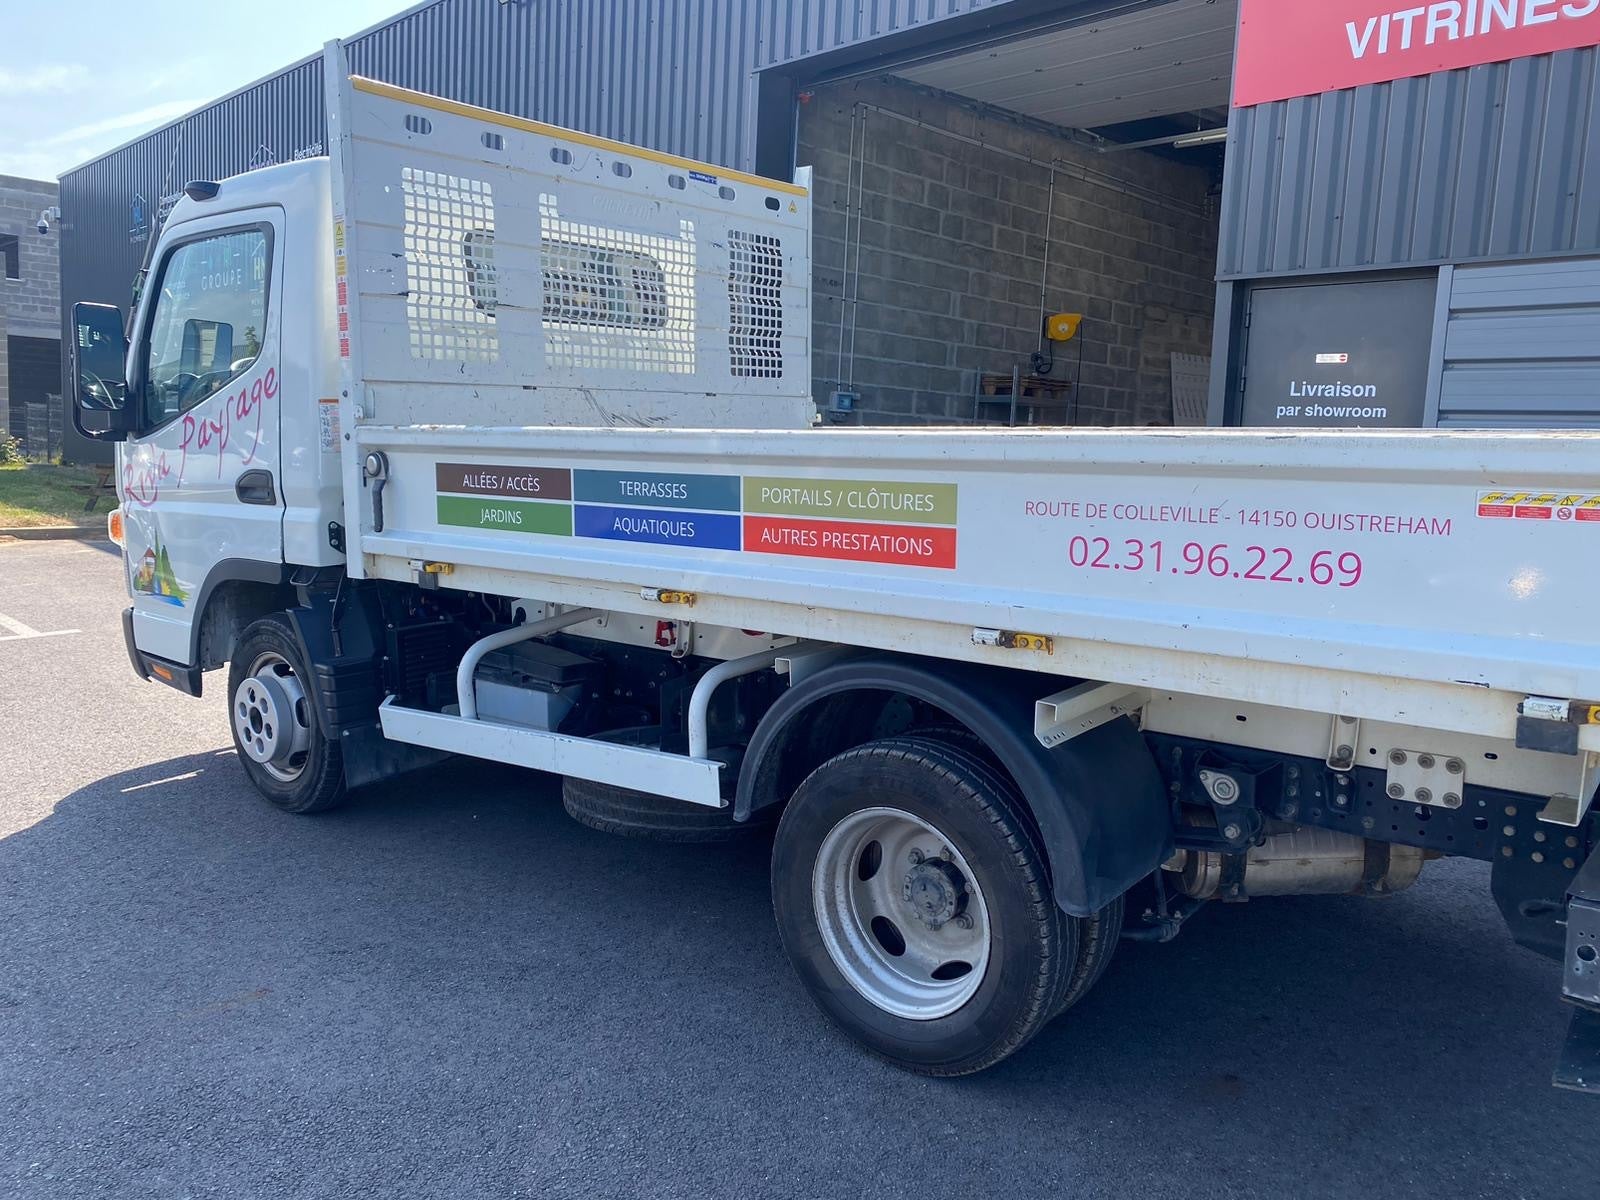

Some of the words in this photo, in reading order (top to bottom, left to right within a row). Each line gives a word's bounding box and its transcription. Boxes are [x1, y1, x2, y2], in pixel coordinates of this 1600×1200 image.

[201, 269, 242, 291] GROUPE
[1289, 381, 1377, 397] Livraison
[1276, 405, 1301, 419] par
[1304, 403, 1387, 418] showroom
[177, 367, 278, 489] Paysage
[462, 471, 498, 489] ALLÉES
[500, 476, 505, 489] /
[506, 473, 540, 492] ACCÈS
[619, 480, 688, 499] TERRASSES
[761, 487, 832, 507] PORTAILS
[836, 491, 843, 507] /
[847, 487, 935, 512] CLÔTURES
[480, 508, 522, 524] JARDINS
[1025, 501, 1080, 518] ROUTE
[1085, 503, 1108, 519] DE
[1113, 504, 1218, 524] COLLEVILLE
[1237, 509, 1297, 528] 14150
[1304, 512, 1451, 536] OUISTREHAM
[613, 517, 695, 538] AQUATIQUES
[761, 527, 818, 547] AUTRES
[822, 531, 933, 556] PRESTATIONS
[1069, 535, 1363, 587] 02.31.96.22.69
